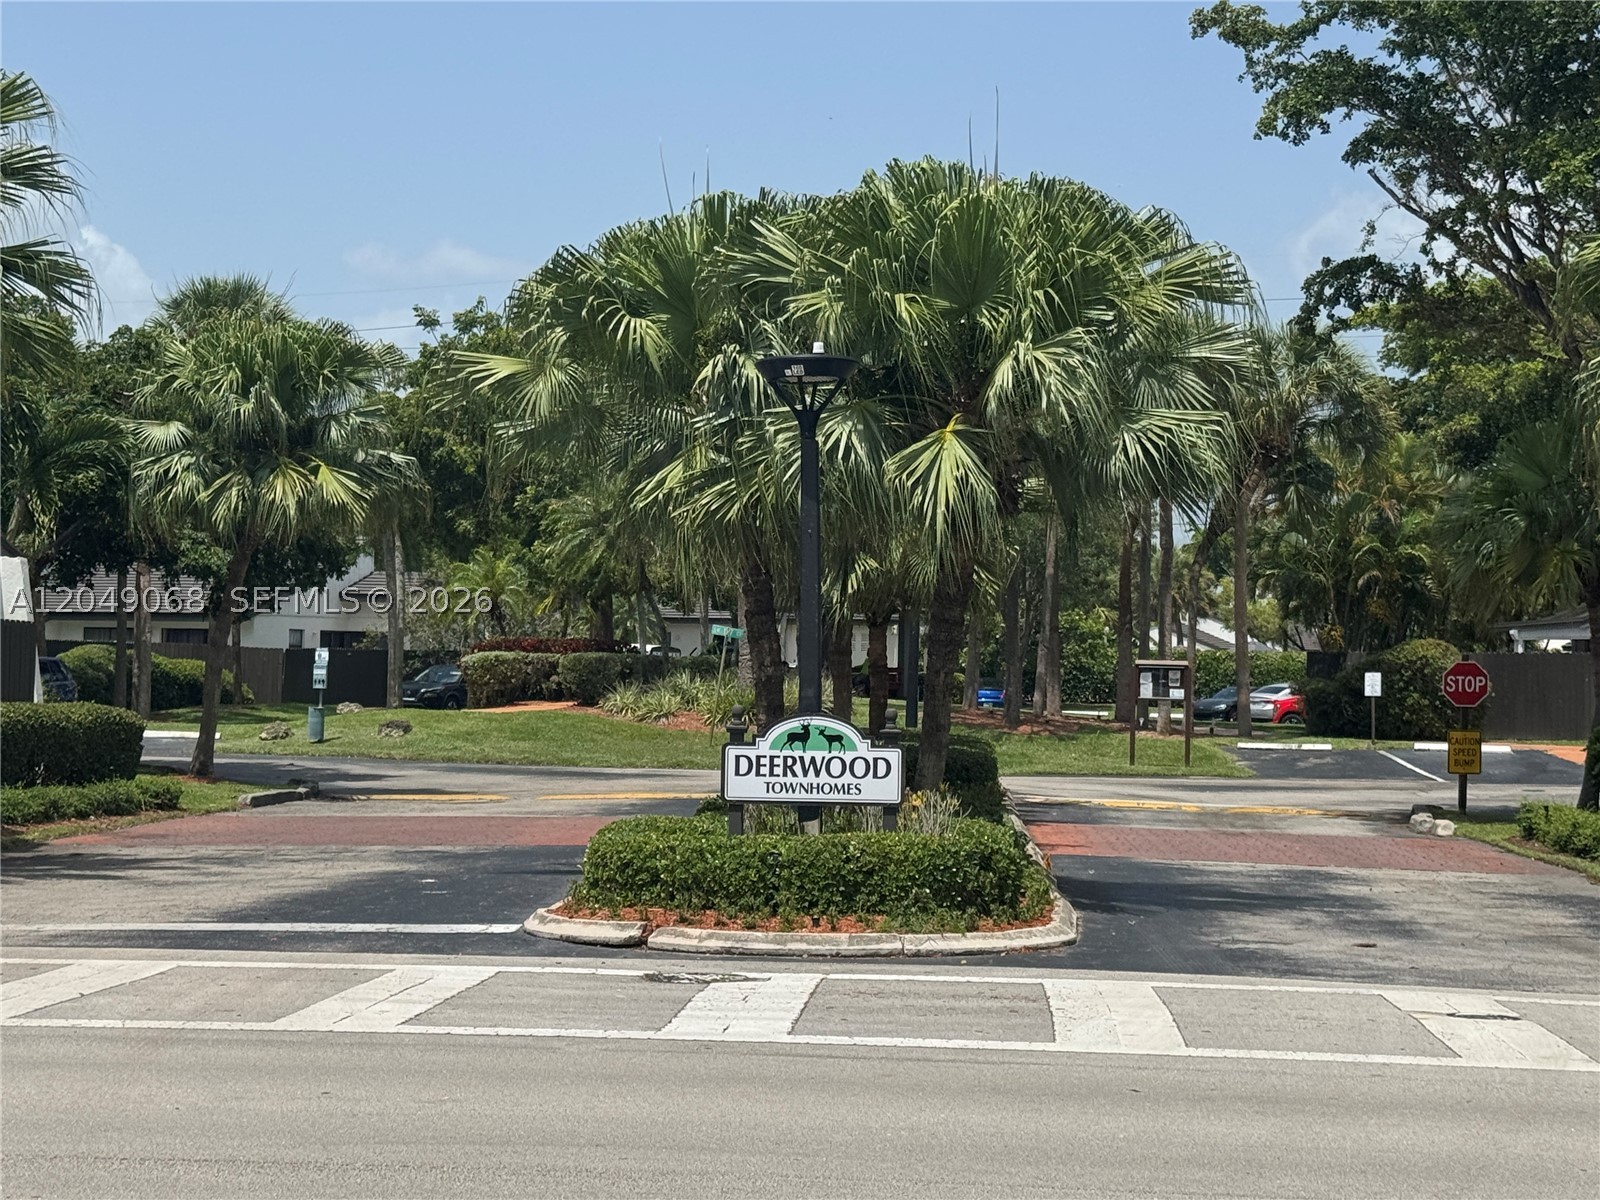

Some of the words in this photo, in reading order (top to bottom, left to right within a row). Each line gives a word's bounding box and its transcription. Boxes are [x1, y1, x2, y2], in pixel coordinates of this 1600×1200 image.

[1446, 675, 1486, 692] STOP
[1450, 737, 1480, 746] CAUTION
[1453, 748, 1476, 757] SPEED
[734, 754, 892, 780] DEERWOOD
[1454, 759, 1475, 768] BUMP
[764, 781, 862, 796] TOWNHOMES
